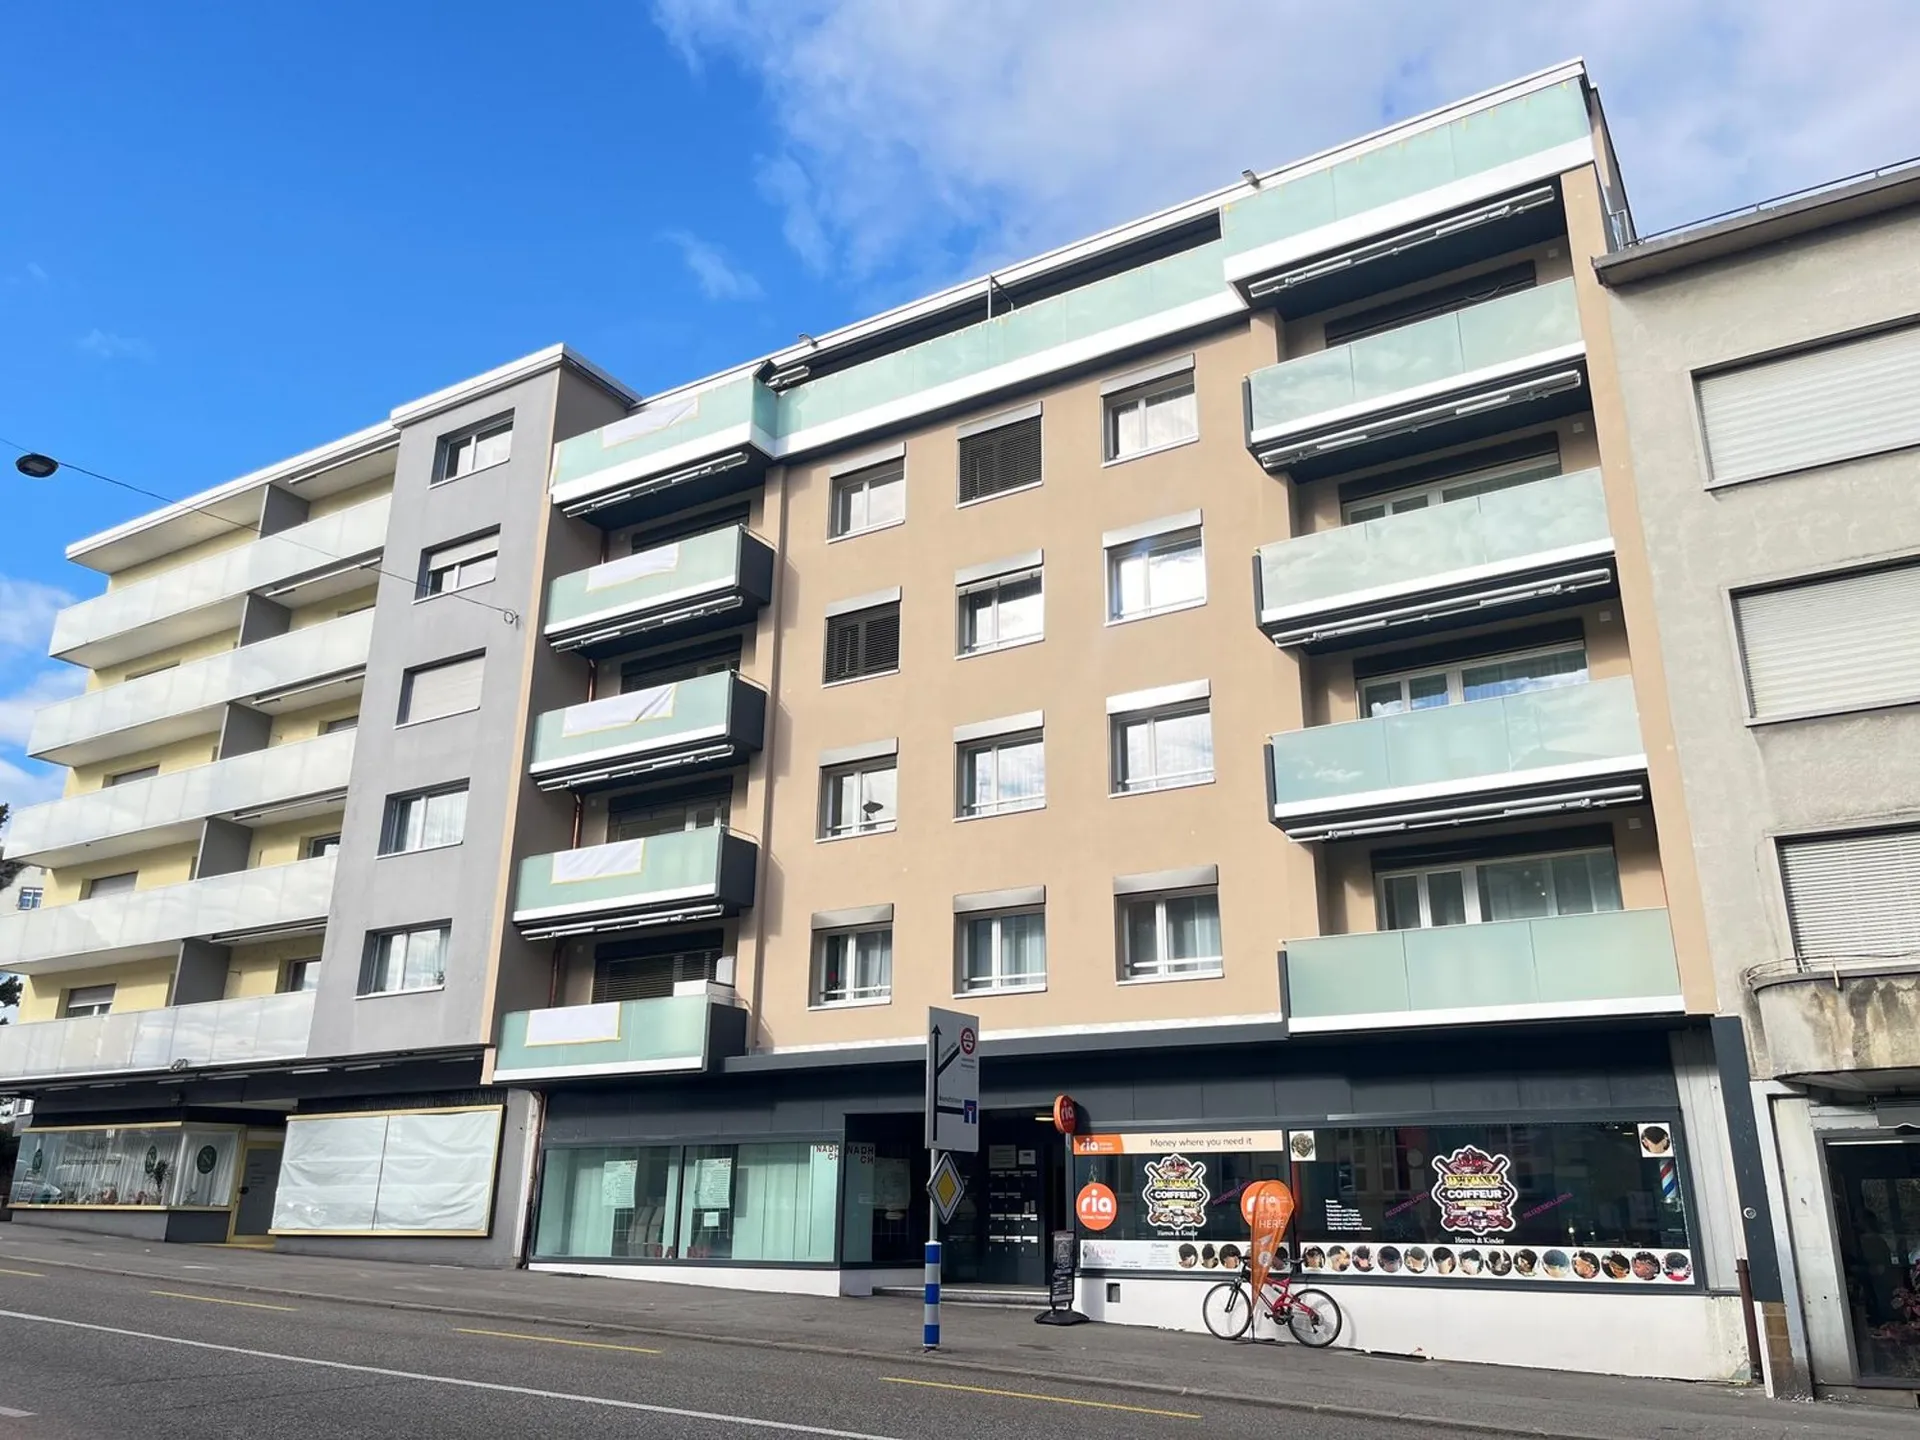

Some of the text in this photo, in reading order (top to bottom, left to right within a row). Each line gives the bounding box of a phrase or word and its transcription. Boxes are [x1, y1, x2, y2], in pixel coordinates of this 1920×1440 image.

[1061, 1101, 1074, 1120] ria
[1080, 1138, 1098, 1152] ria
[1150, 1137, 1253, 1148] Money where you need it
[860, 1155, 874, 1164] CH
[1155, 1191, 1198, 1199] COIFFEUR
[1447, 1189, 1502, 1199] COIFFEUR
[1081, 1189, 1112, 1213] ria
[1259, 1220, 1285, 1229] HERE
